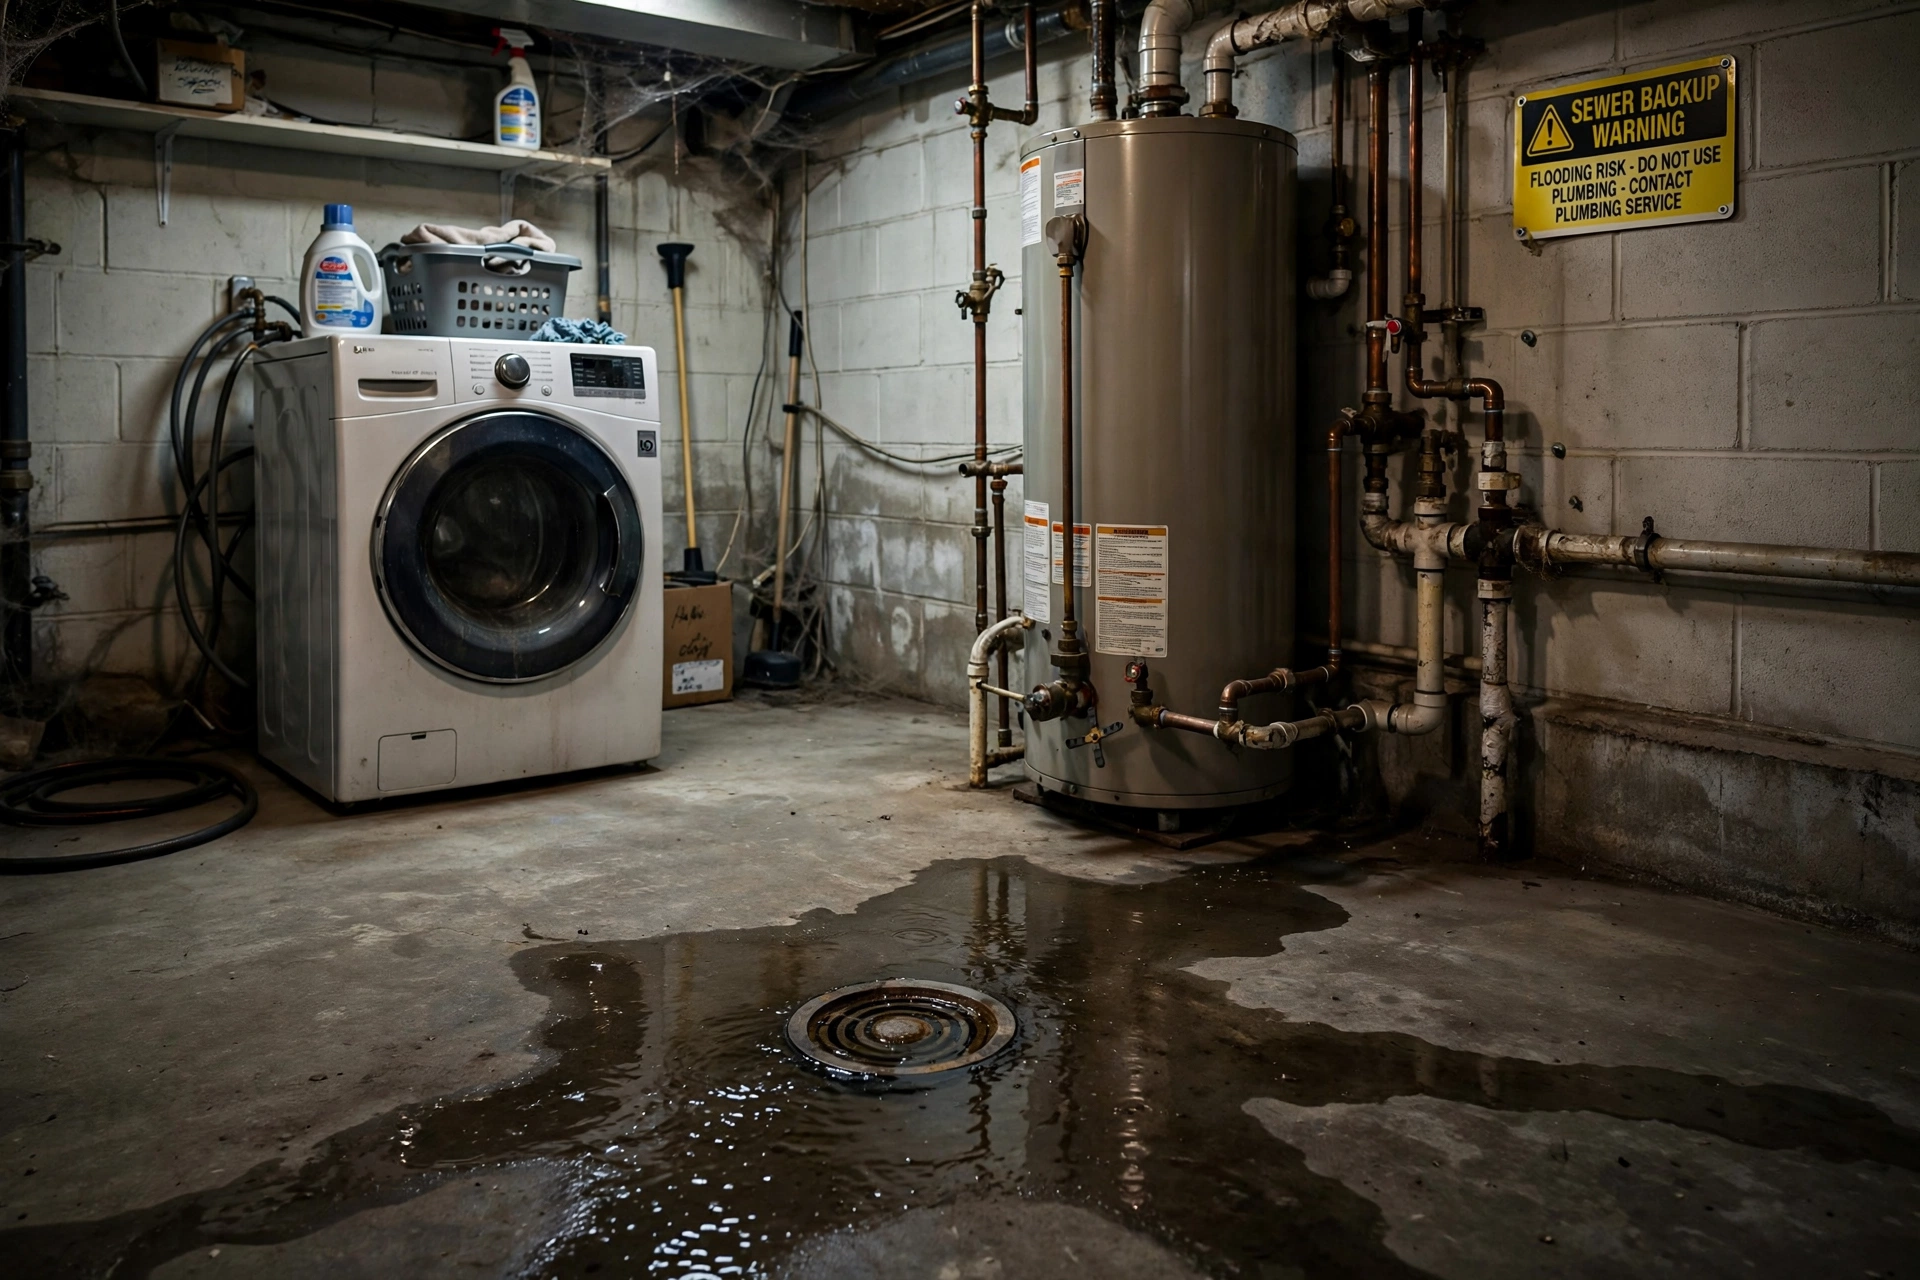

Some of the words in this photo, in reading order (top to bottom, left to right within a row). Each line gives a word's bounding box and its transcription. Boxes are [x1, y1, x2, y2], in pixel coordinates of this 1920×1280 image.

[1572, 90, 1634, 123] SEWER
[1641, 74, 1720, 111] BACKUP
[1592, 110, 1684, 148] WARNING
[1530, 164, 1592, 188] FLOODING
[1596, 159, 1626, 178] RISK
[1639, 155, 1657, 172] DO
[1661, 150, 1689, 170] NOT
[1693, 145, 1721, 166] USE
[1552, 181, 1616, 204] PLUMBING
[1629, 171, 1693, 194] CONTACT
[1555, 200, 1621, 223] PLUMBING
[1626, 193, 1681, 215] SERVICE
